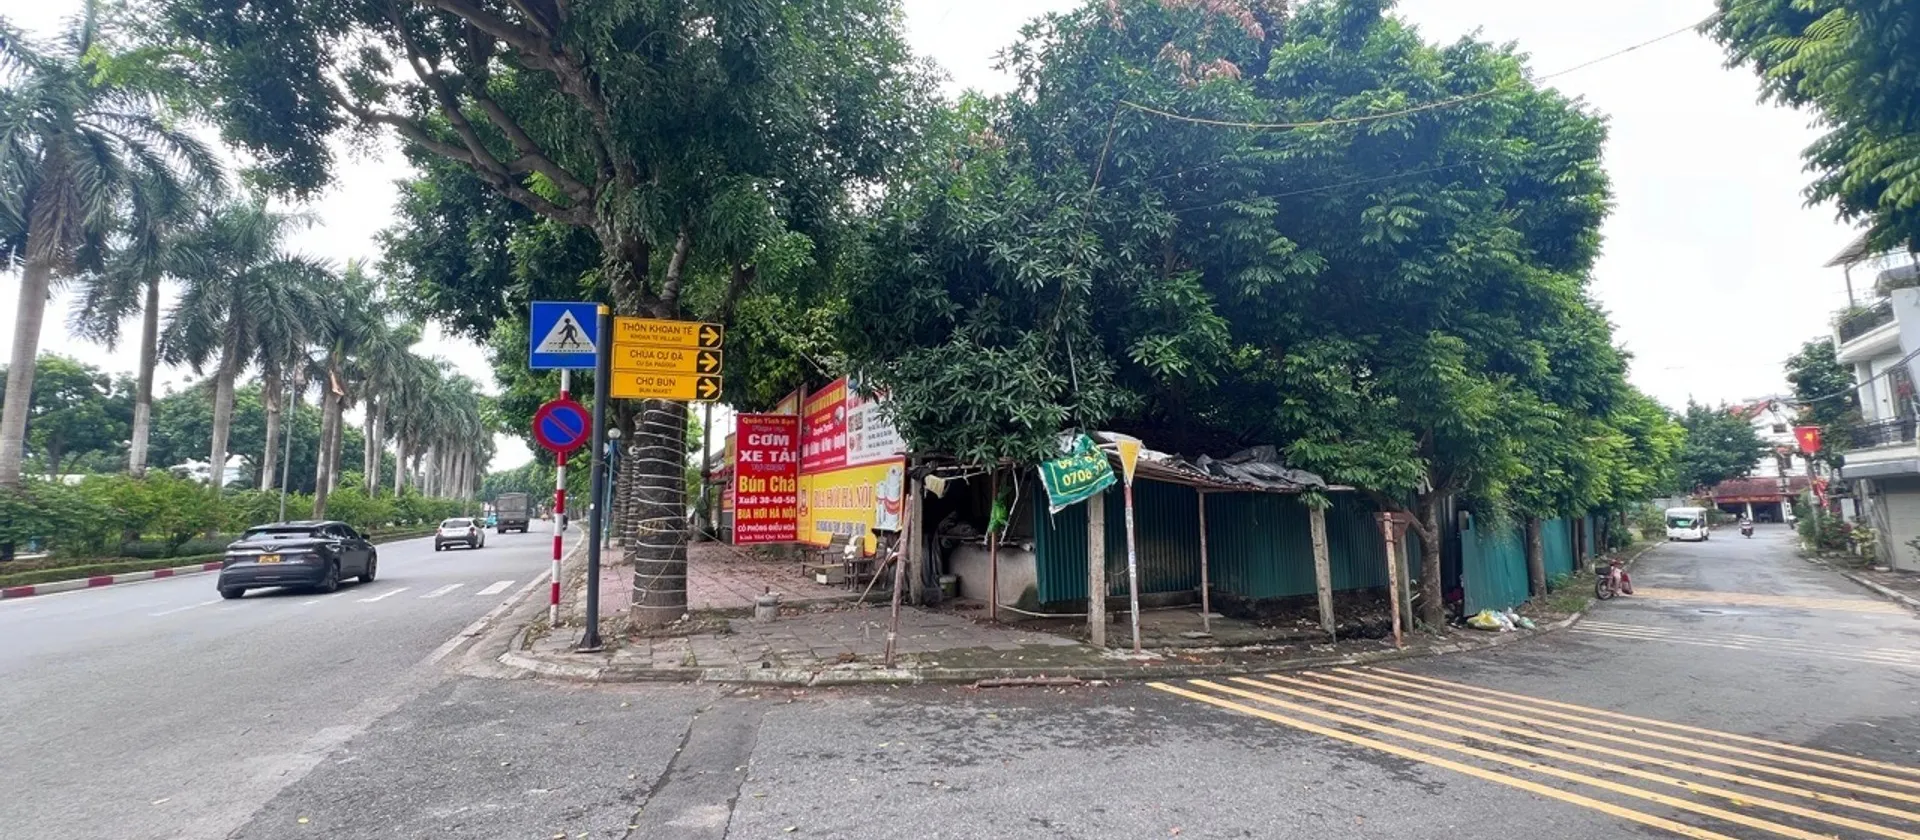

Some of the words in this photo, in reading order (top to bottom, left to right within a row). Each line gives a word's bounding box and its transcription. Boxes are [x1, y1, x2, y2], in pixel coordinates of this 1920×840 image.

[623, 322, 647, 332] THÔN
[649, 324, 681, 334] KHOAN
[743, 417, 763, 425] Quán
[748, 433, 790, 446] CƠM
[739, 450, 763, 462] XE
[769, 447, 797, 463] TẢI
[739, 474, 766, 493] Bún
[769, 473, 796, 493] Chả
[738, 495, 758, 504] Xuất
[759, 495, 796, 504] 30-40-50
[813, 488, 825, 508] BIA
[854, 478, 873, 514] NỘI
[737, 508, 752, 520] BIA
[752, 507, 768, 519] HƠI
[769, 505, 780, 519] HÀ
[782, 505, 796, 521] NỘI
